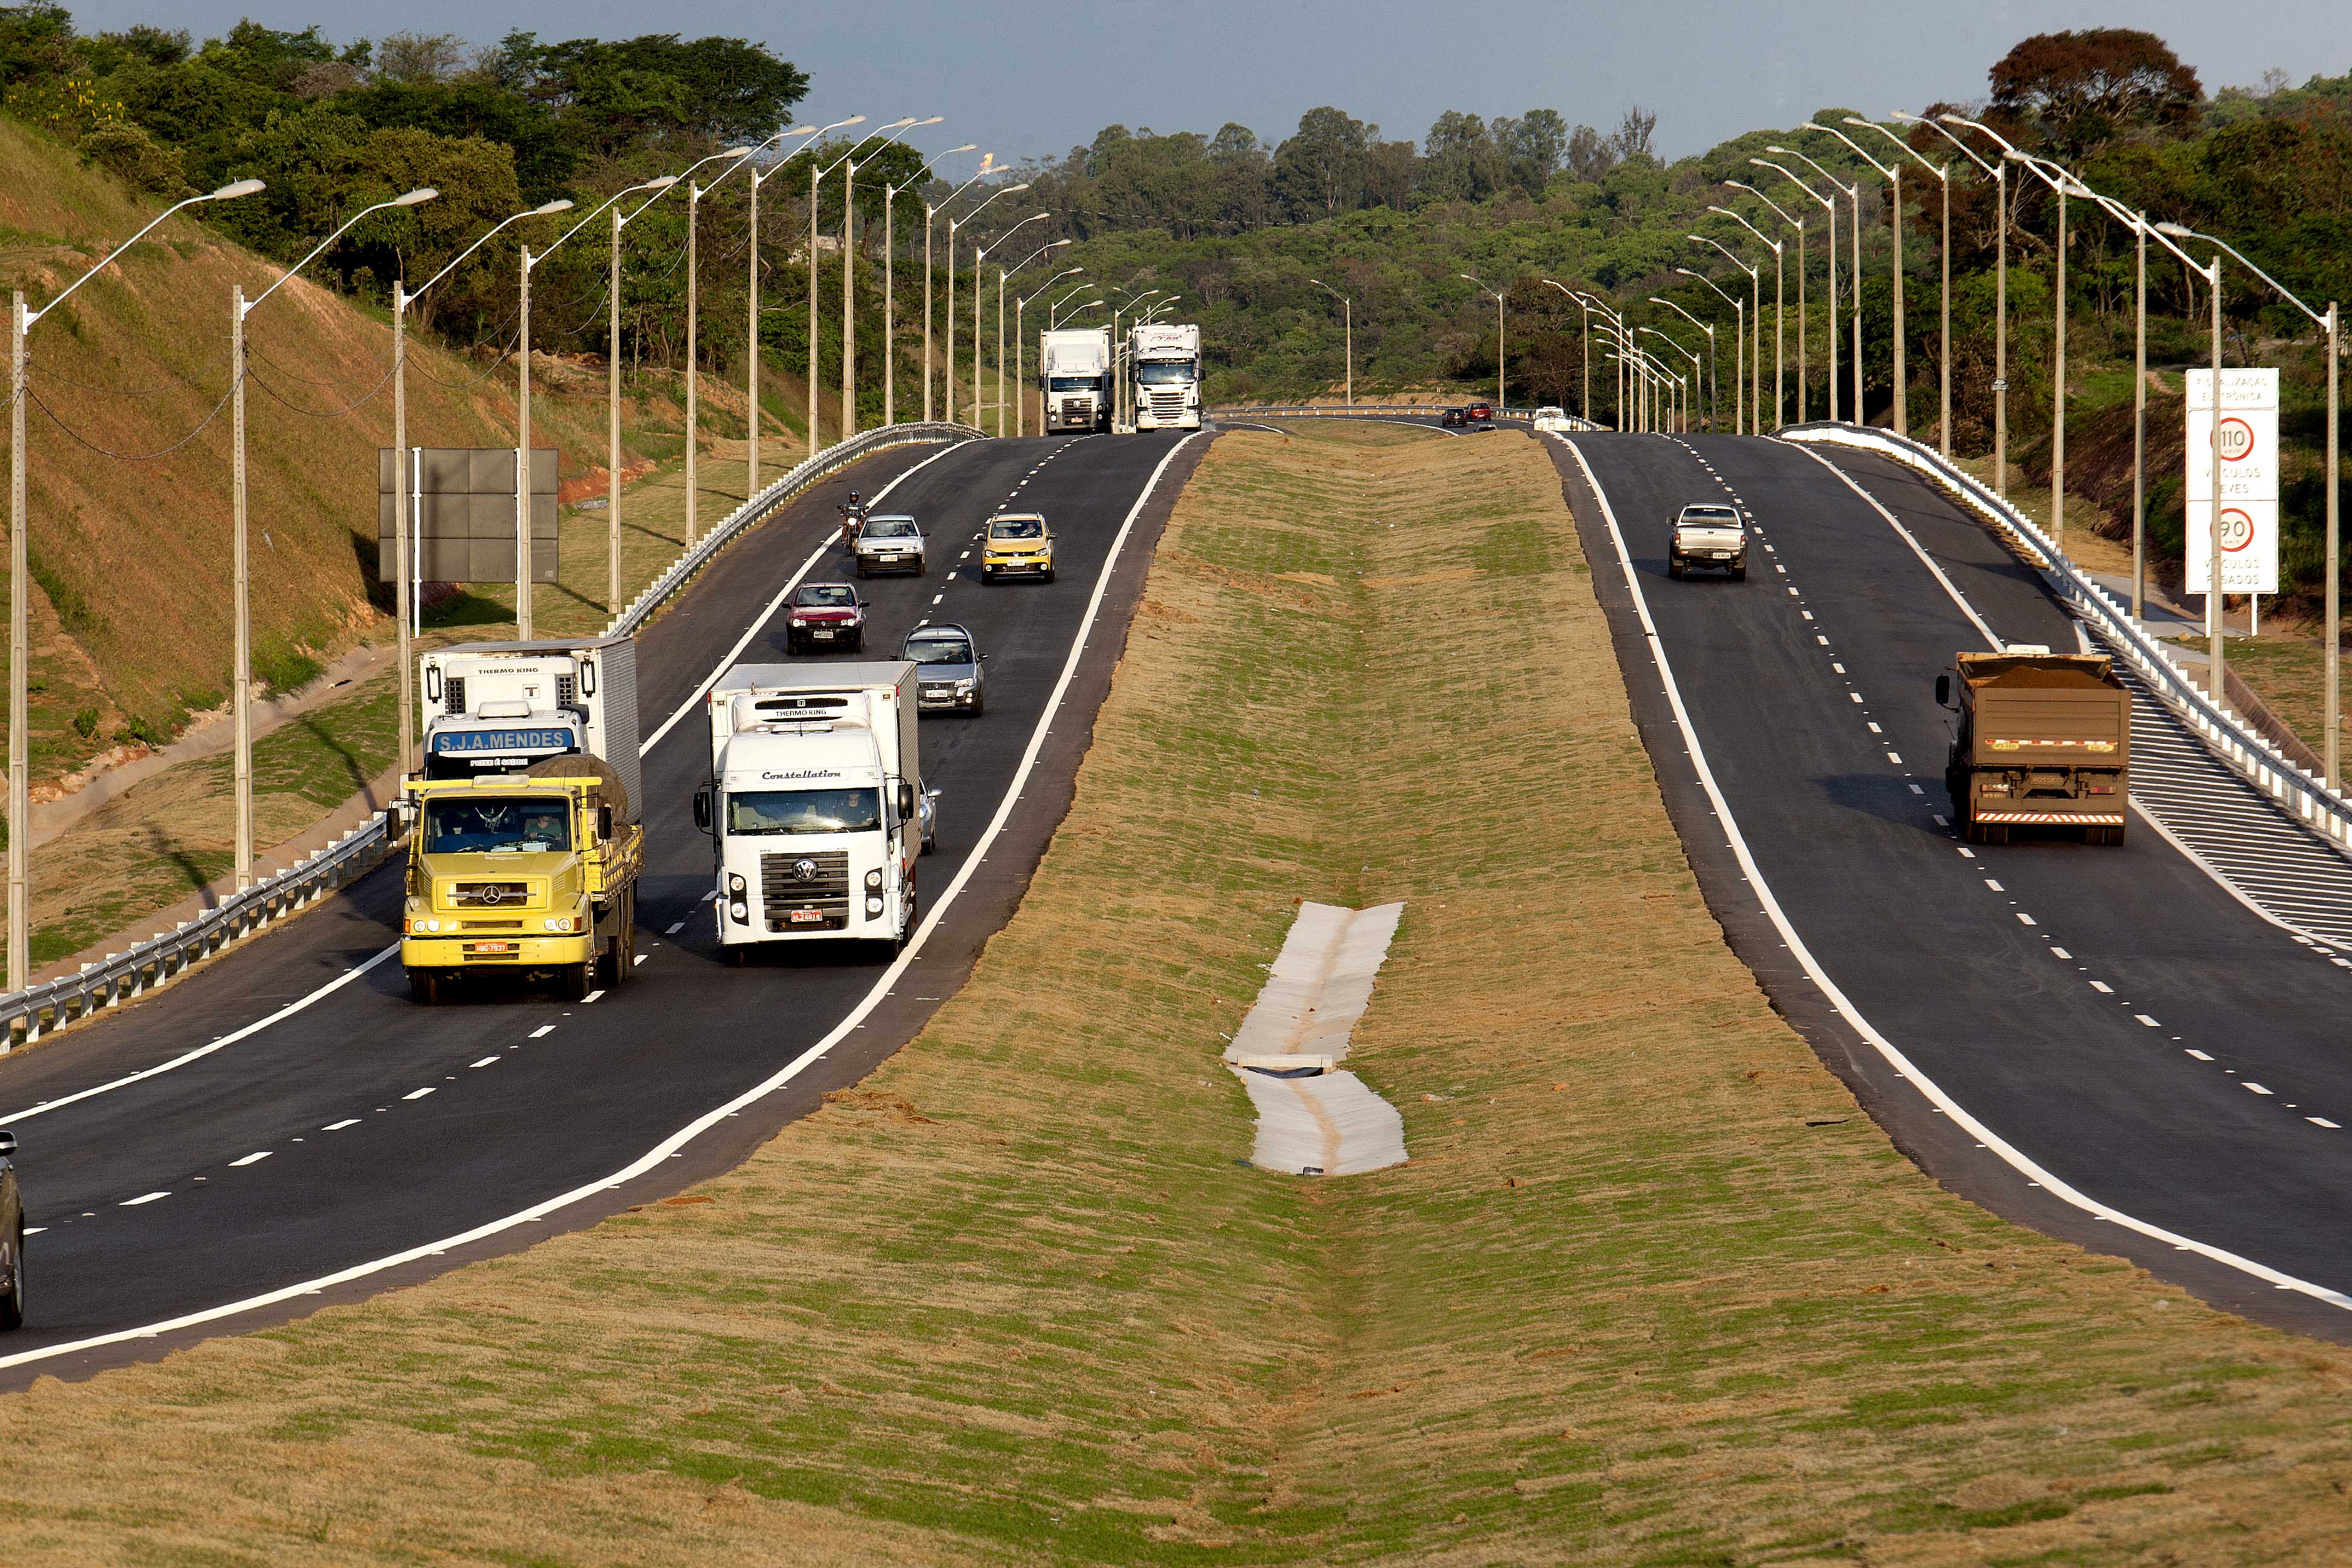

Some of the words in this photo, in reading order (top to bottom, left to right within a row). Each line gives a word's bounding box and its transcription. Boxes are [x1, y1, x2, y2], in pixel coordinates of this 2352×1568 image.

[2197, 376, 2268, 387] FISALIZAÇÃO
[2202, 390, 2264, 401] ELTRÔNICA
[2221, 430, 2245, 446] 110
[2204, 468, 2261, 477] VCULOS
[2221, 521, 2245, 537] 90
[2204, 558, 2260, 569] VCULOS
[2206, 575, 2259, 584] PSADOS
[440, 731, 564, 752] S.J.A.MENDES
[762, 769, 841, 780] Constellation
